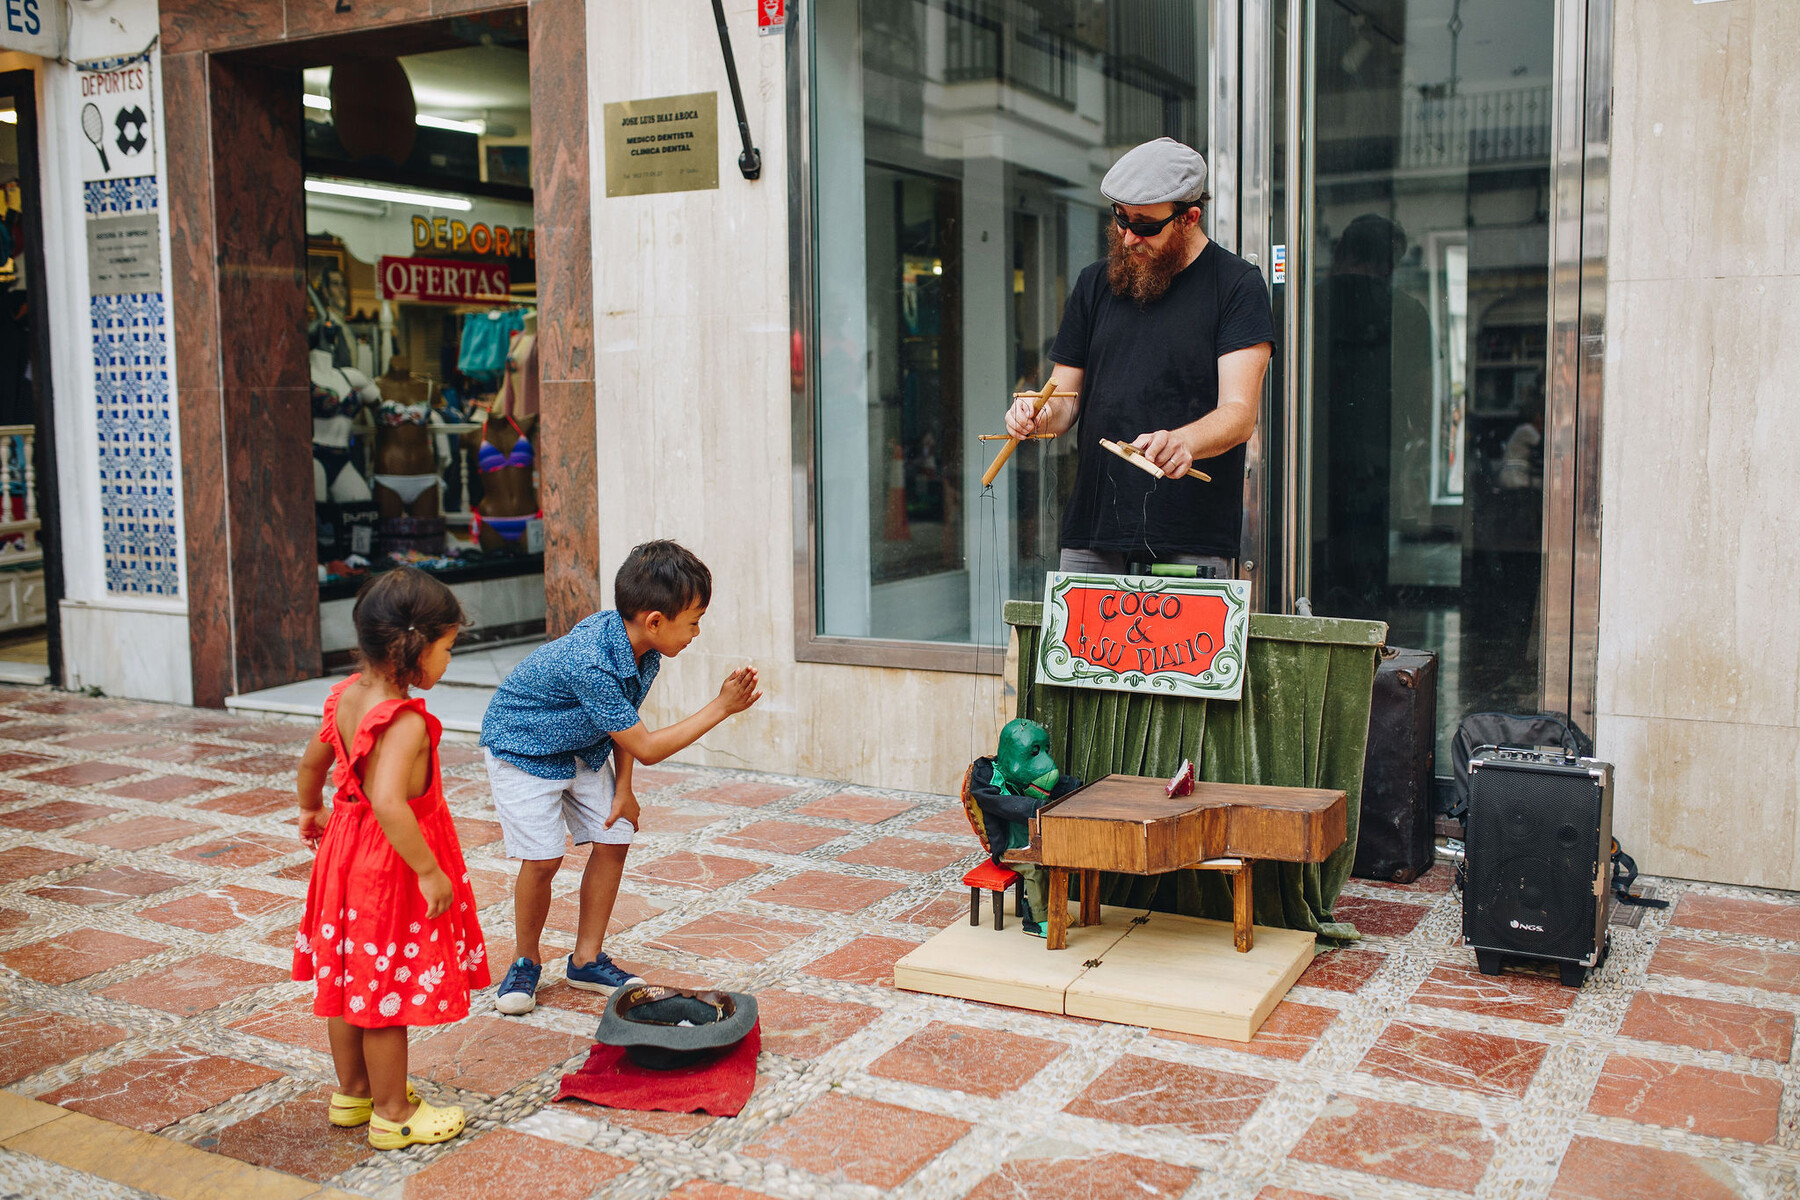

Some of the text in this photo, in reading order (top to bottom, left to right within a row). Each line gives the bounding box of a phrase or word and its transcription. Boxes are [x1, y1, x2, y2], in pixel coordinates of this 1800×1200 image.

[6, 0, 40, 35] ES
[81, 68, 144, 97] DEPORTES
[622, 116, 639, 126] JOSE
[627, 131, 694, 144] MEDICO DENTISTA
[630, 144, 691, 156] CLINICA DENTAL
[386, 262, 506, 298] OFERTAS
[1099, 591, 1182, 621] COCO
[1126, 616, 1153, 645] &
[1090, 632, 1214, 671] SU PIANO
[1519, 923, 1544, 932] NGS
